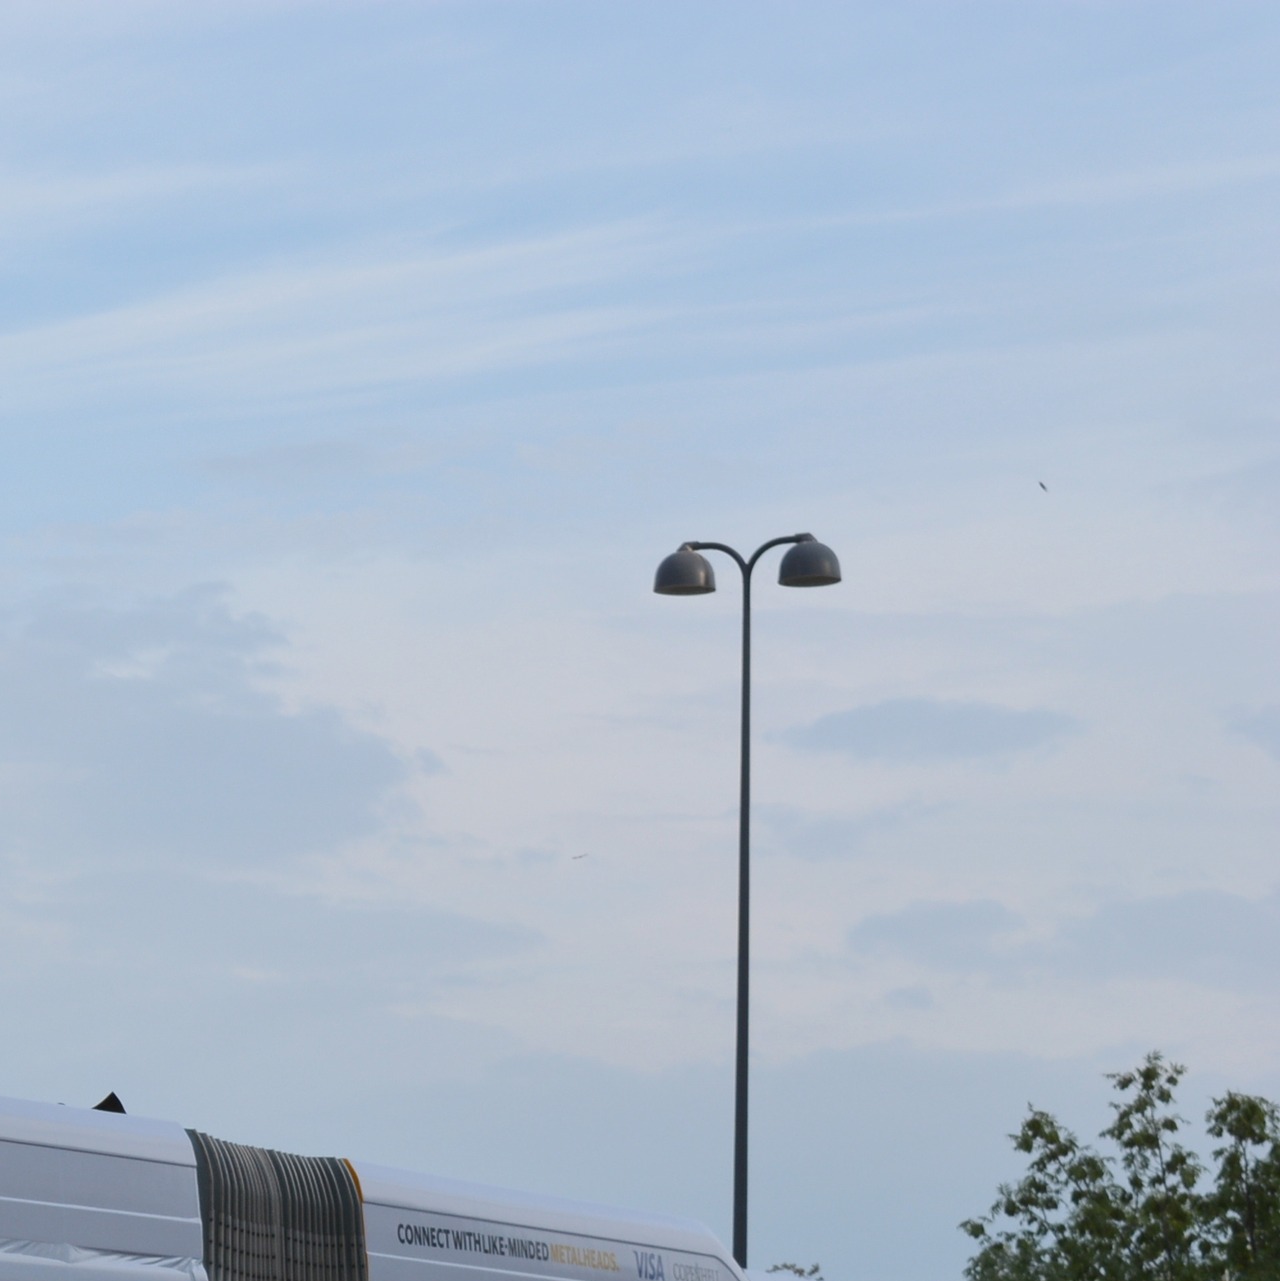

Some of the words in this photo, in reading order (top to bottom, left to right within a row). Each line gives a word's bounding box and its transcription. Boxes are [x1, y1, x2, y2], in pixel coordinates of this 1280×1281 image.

[397, 1223, 450, 1249] CONNECT
[451, 1230, 481, 1252] WITH
[633, 1251, 665, 1281] VISA
